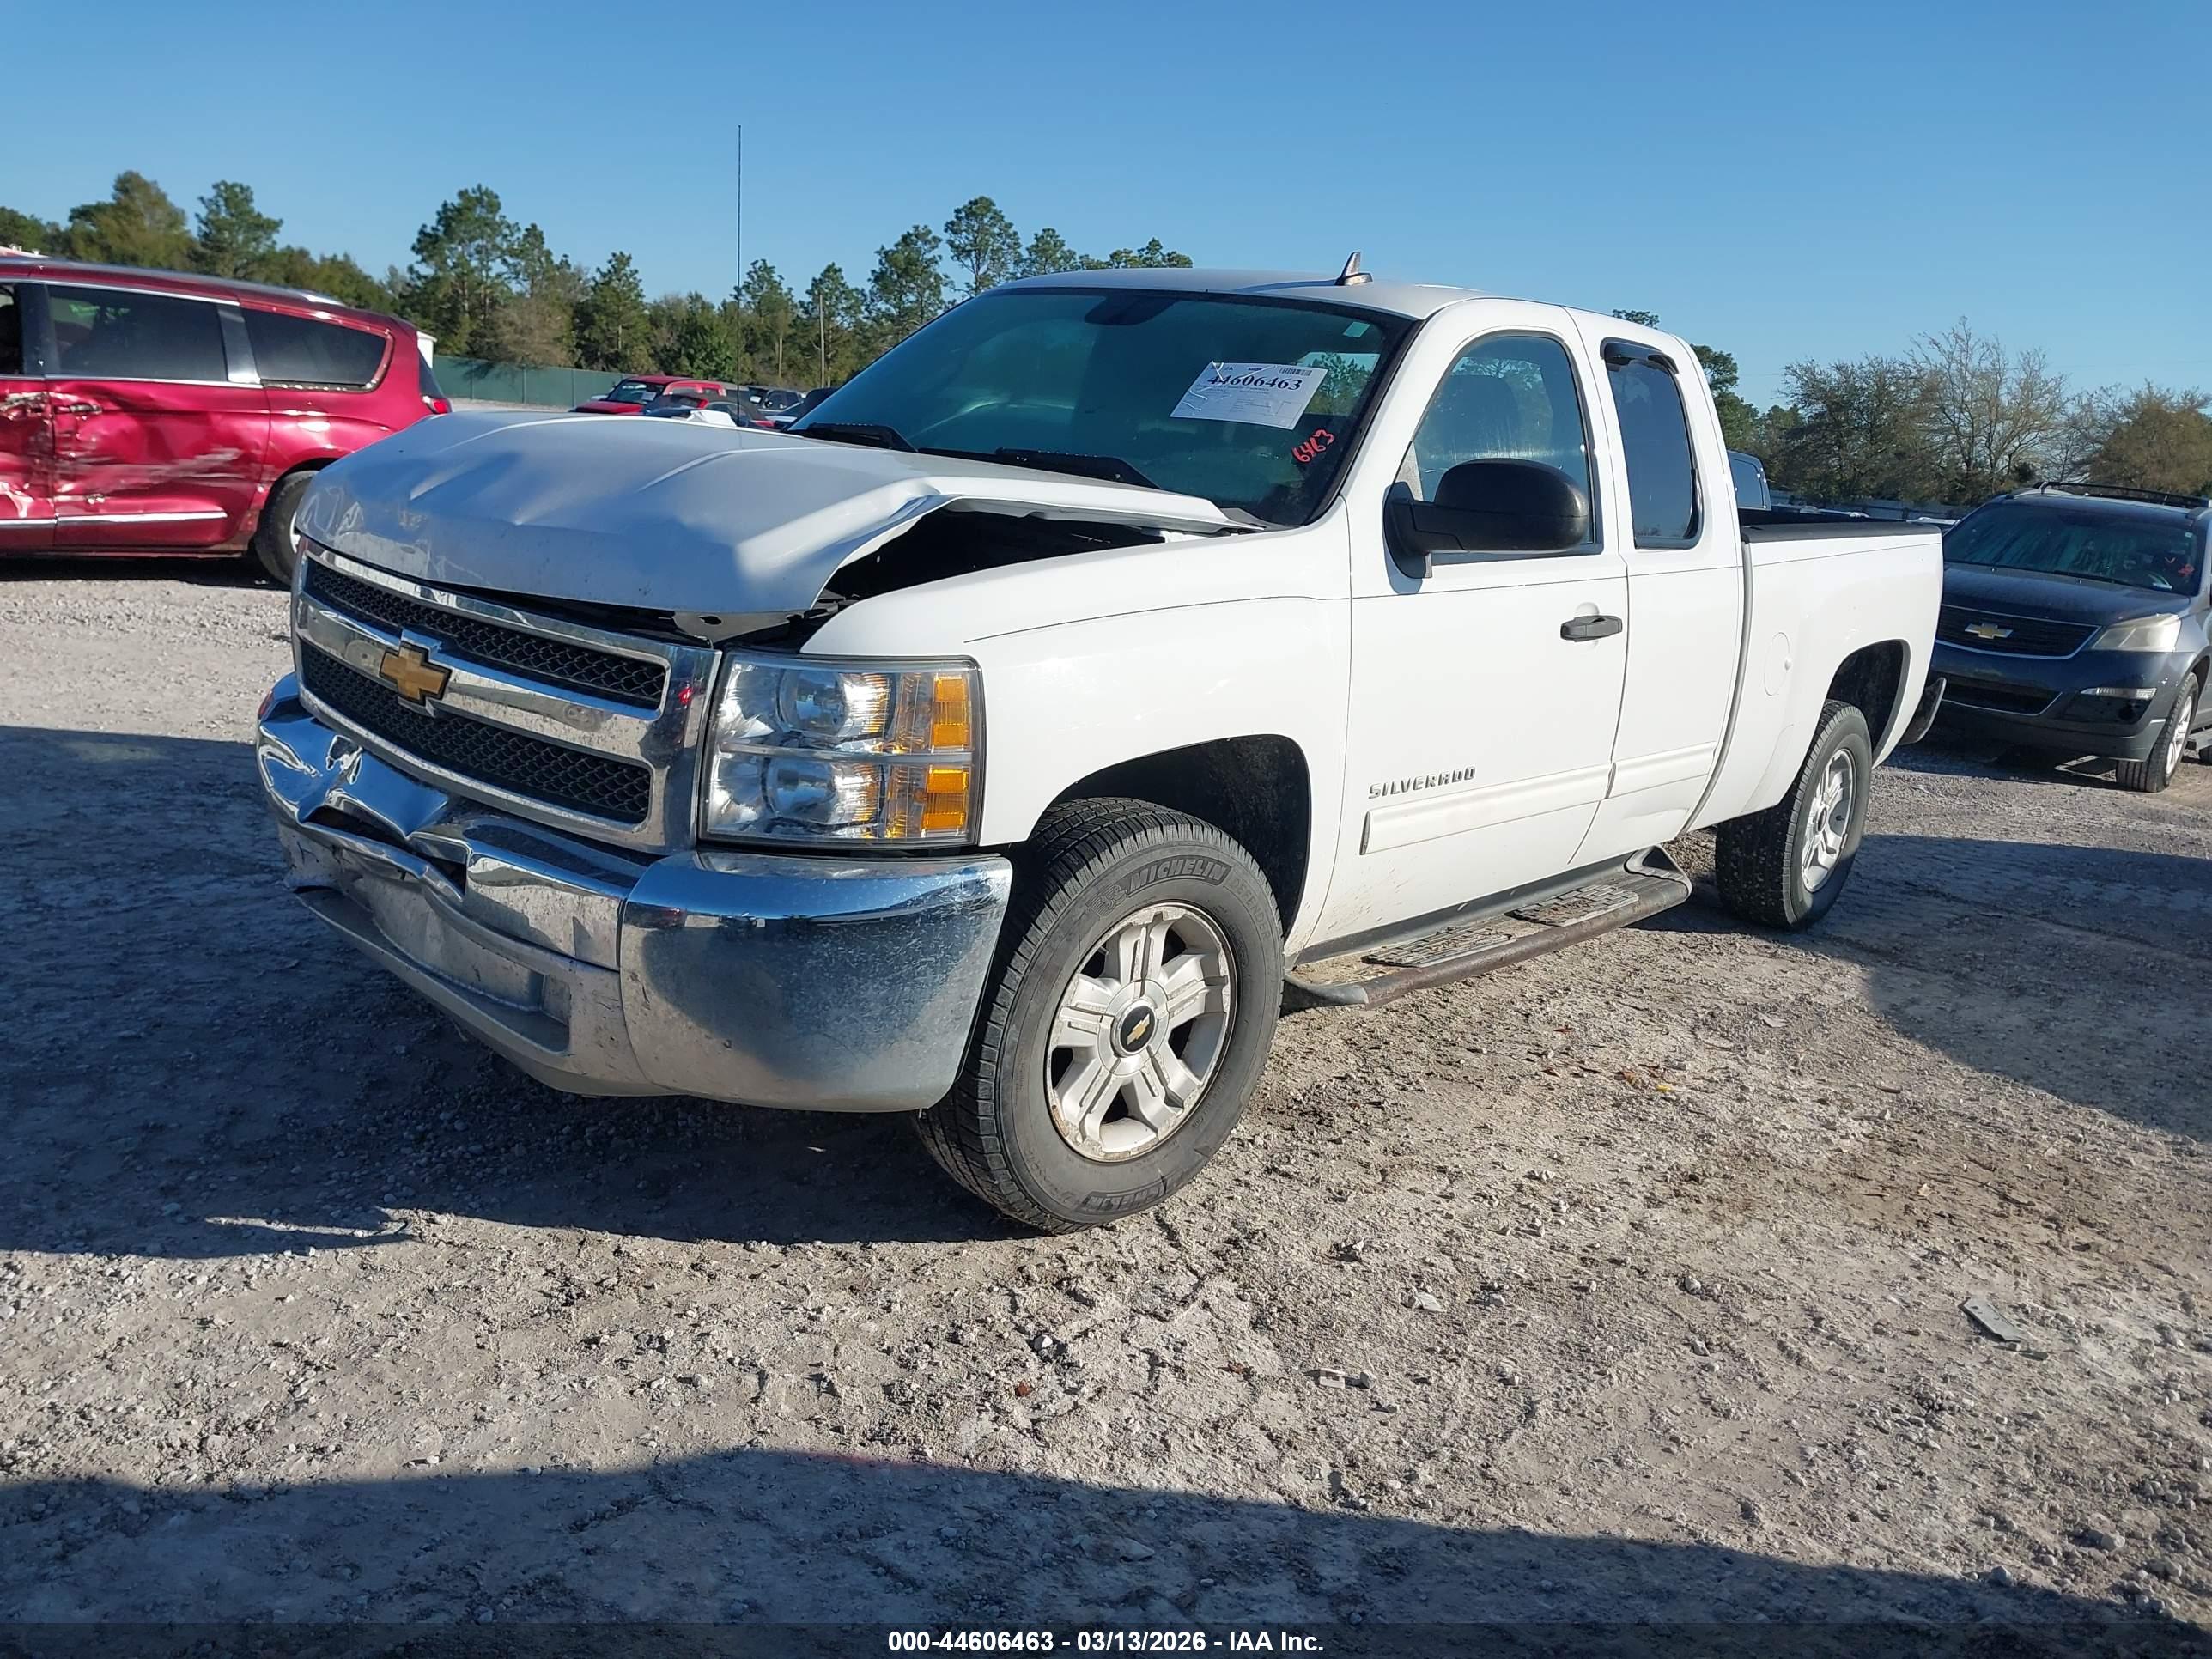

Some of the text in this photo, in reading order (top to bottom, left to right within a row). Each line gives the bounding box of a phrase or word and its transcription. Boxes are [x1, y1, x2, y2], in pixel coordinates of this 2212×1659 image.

[1207, 374, 1303, 391] 44606463
[1368, 765, 1476, 799] SILVERADO
[1127, 857, 1226, 893] MICHELIN
